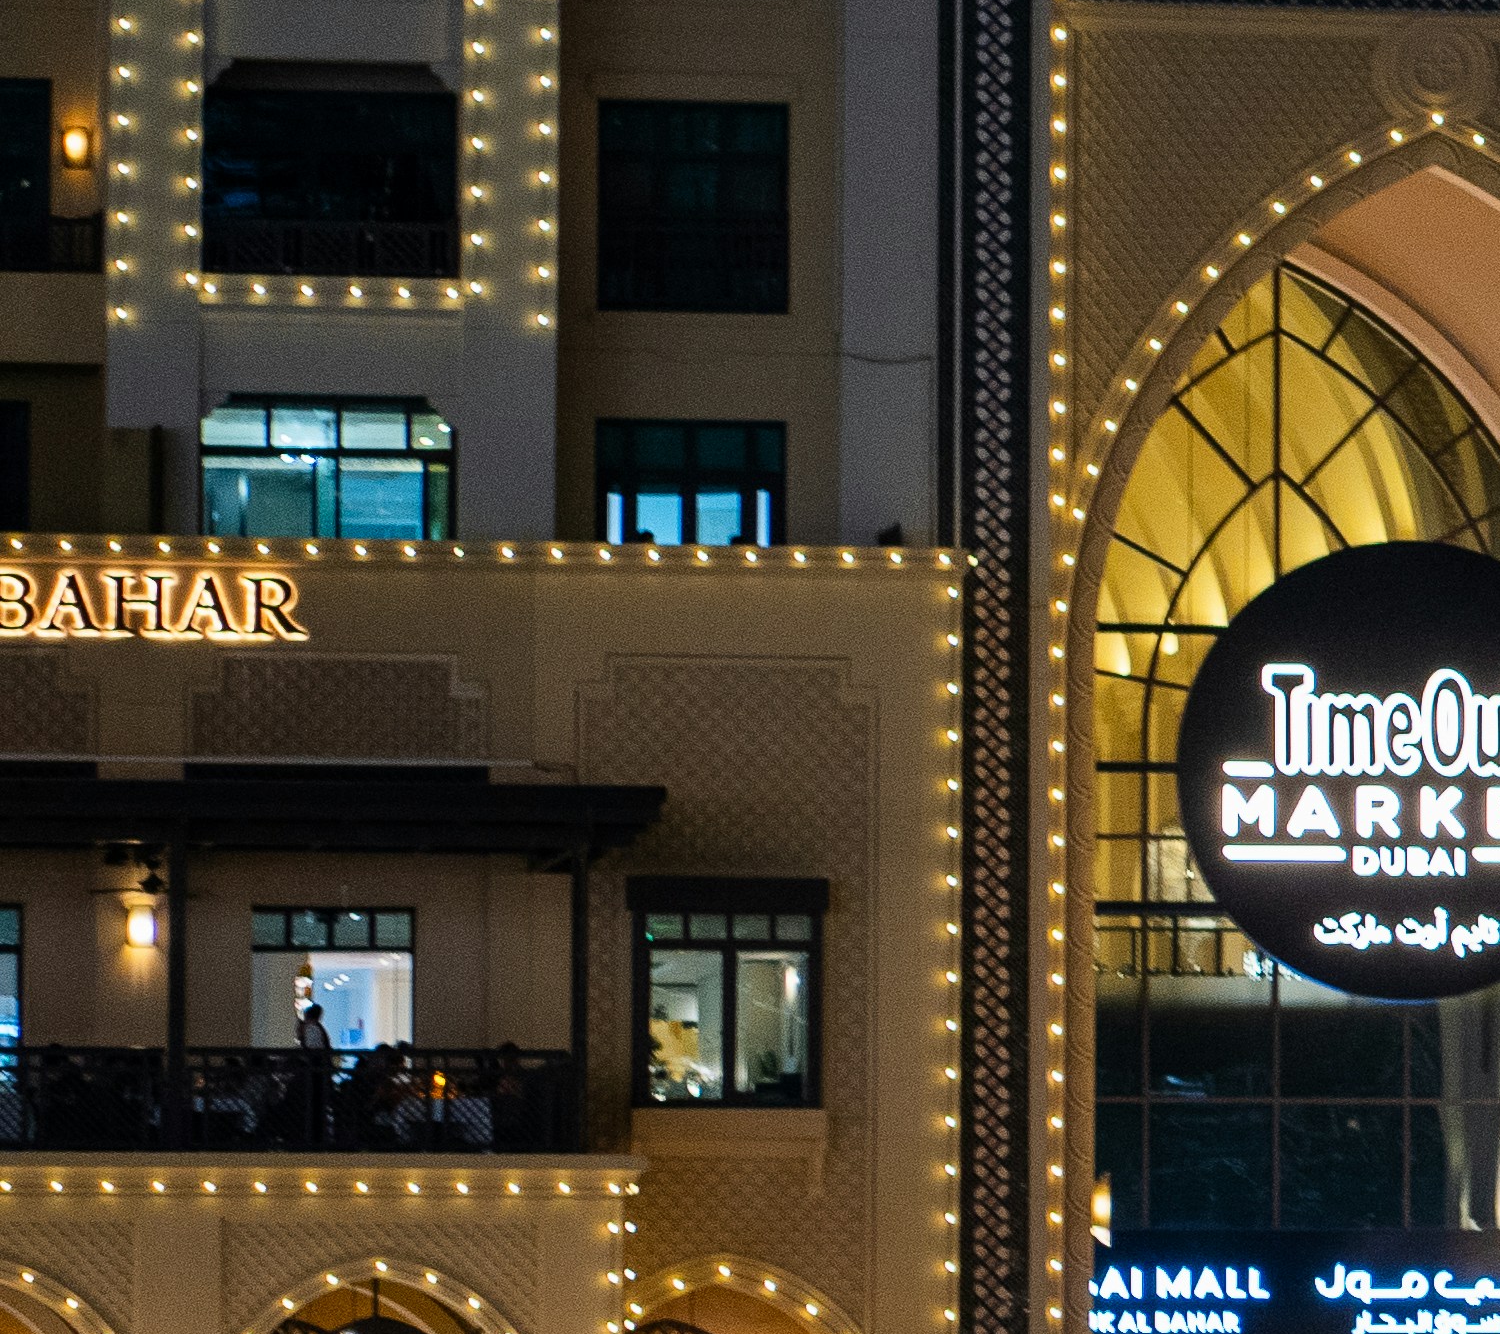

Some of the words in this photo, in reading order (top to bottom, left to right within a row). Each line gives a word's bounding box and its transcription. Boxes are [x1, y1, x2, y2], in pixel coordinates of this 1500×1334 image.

[0, 569, 309, 641] BAHAR
[1352, 845, 1468, 877] DUBAI
[1155, 1265, 1271, 1300] MALL
[1314, 1261, 1430, 1305] مول
[1117, 1310, 1153, 1334] AL
[1154, 1310, 1241, 1334] BAHAR
